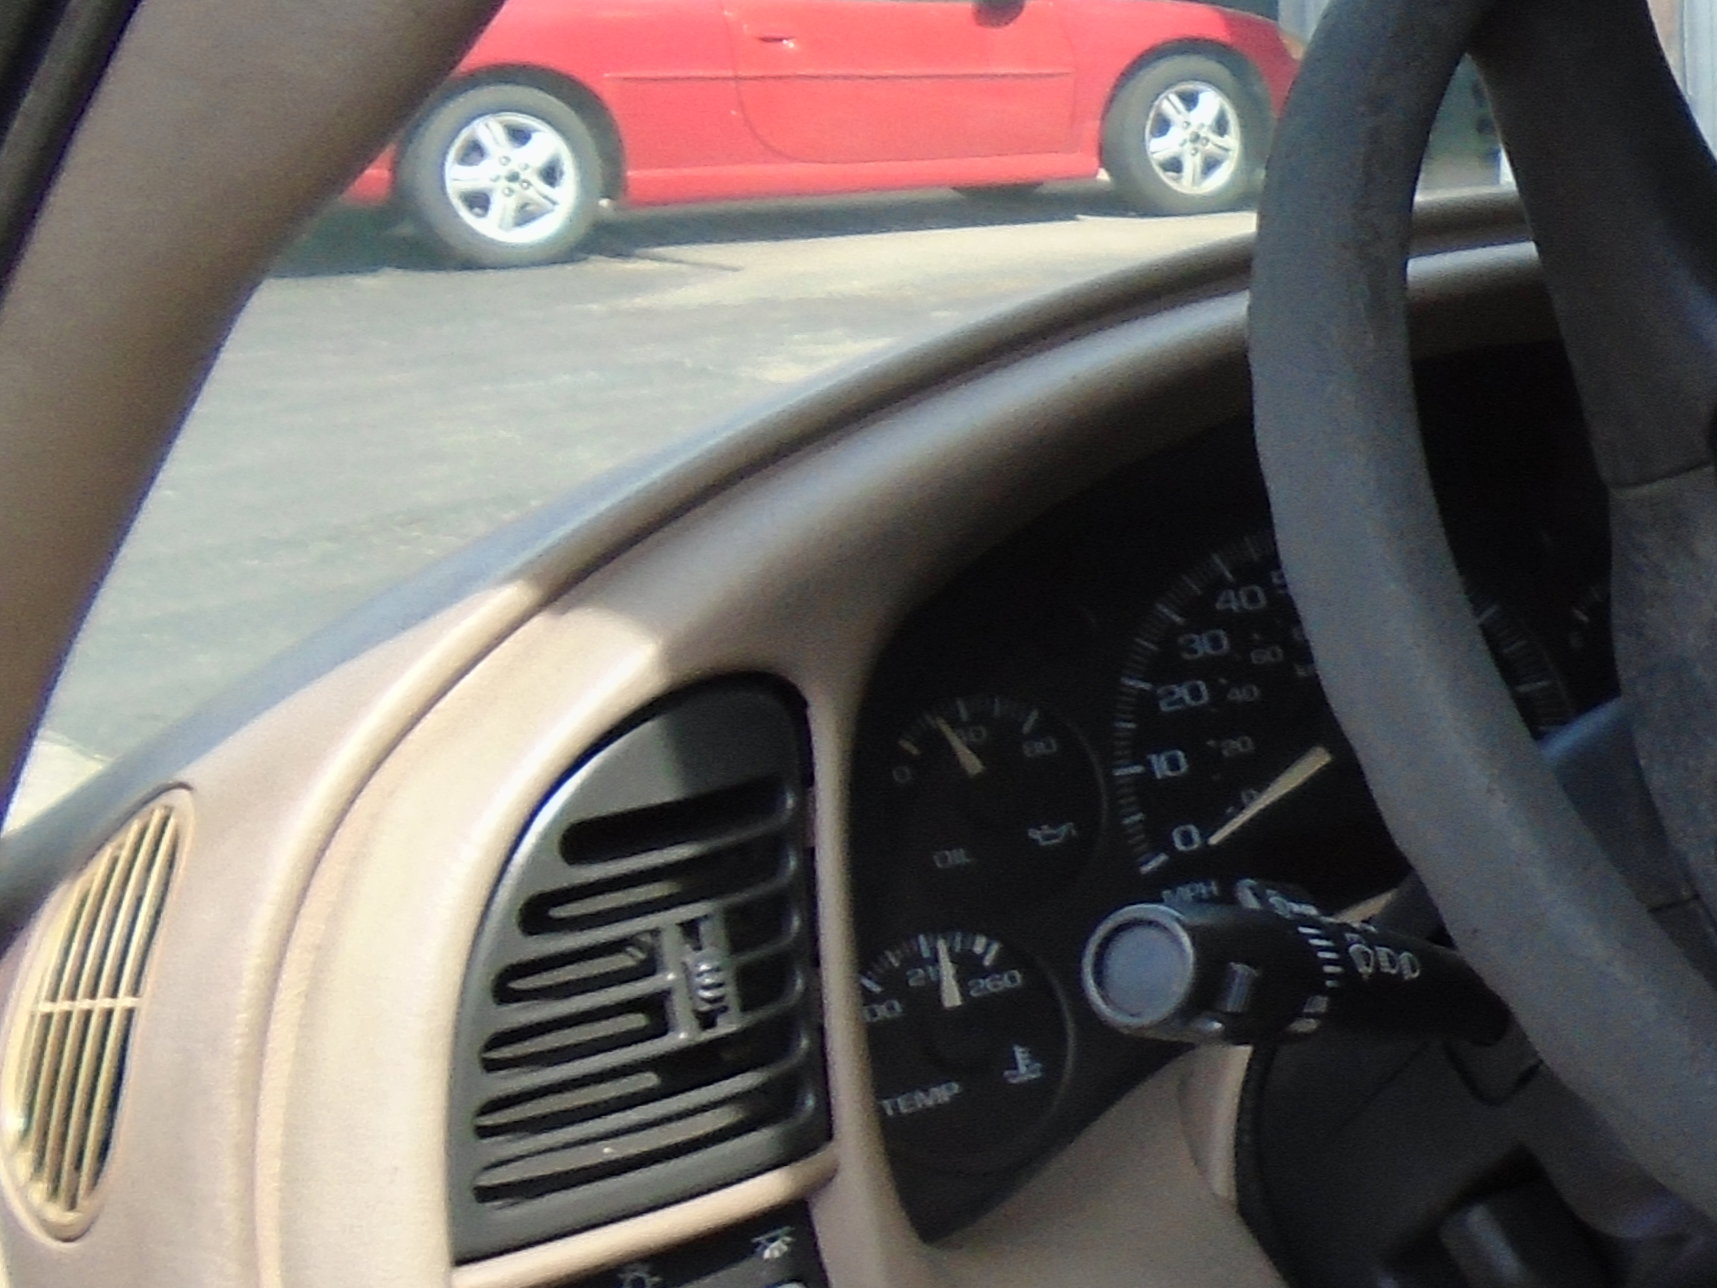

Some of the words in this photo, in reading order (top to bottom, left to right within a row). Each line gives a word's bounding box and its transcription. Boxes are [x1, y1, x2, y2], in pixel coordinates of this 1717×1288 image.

[1215, 584, 1267, 612] 40
[1178, 628, 1230, 660] 30
[1156, 680, 1210, 713] 20
[1150, 747, 1190, 779] 10
[1171, 824, 1202, 853] 0
[967, 969, 1024, 998] 260
[881, 1080, 961, 1117] TEMP
